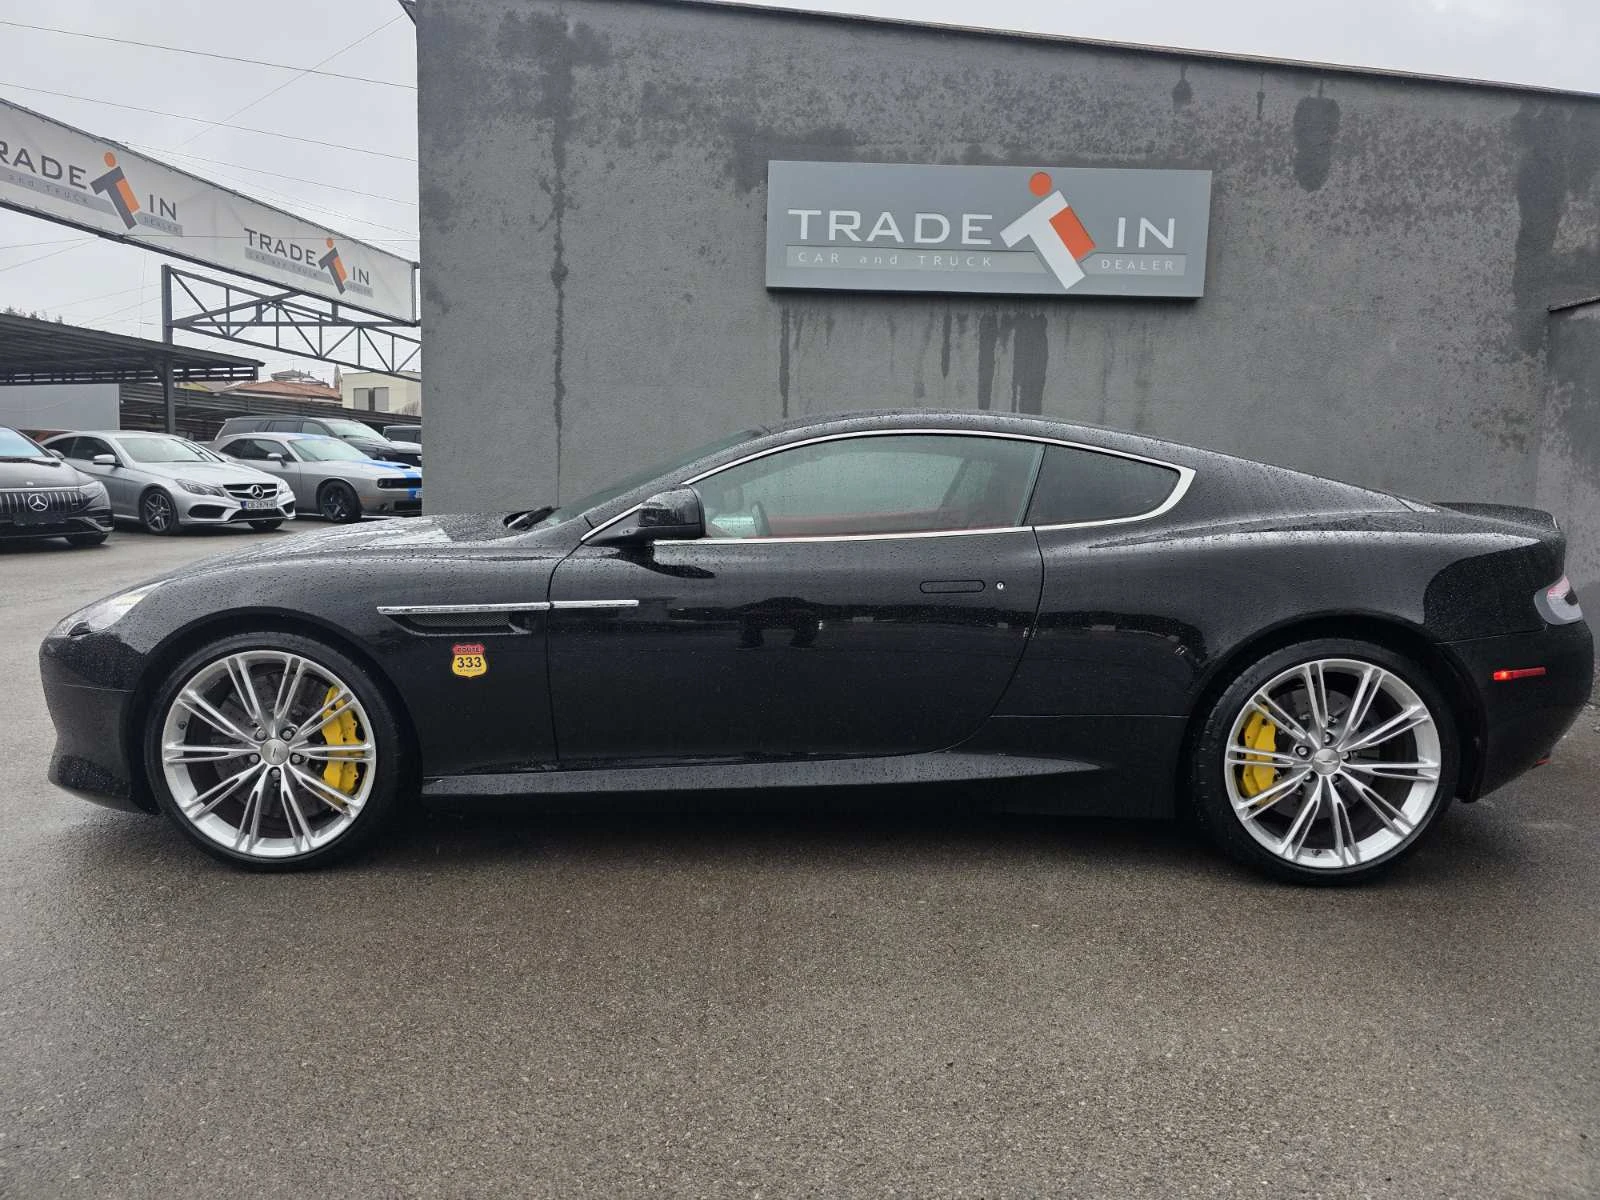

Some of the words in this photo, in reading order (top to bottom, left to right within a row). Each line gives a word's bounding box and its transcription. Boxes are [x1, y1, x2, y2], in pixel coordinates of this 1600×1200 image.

[150, 194, 176, 221] IN
[787, 208, 993, 245] TRADE
[1116, 216, 1176, 249] IN
[244, 227, 317, 267] TRADE
[353, 265, 370, 286] IN
[797, 250, 841, 264] CAR
[858, 253, 899, 265] and
[917, 254, 992, 267] TRUCK
[1100, 258, 1175, 271] DEALER
[456, 656, 482, 668] 333
